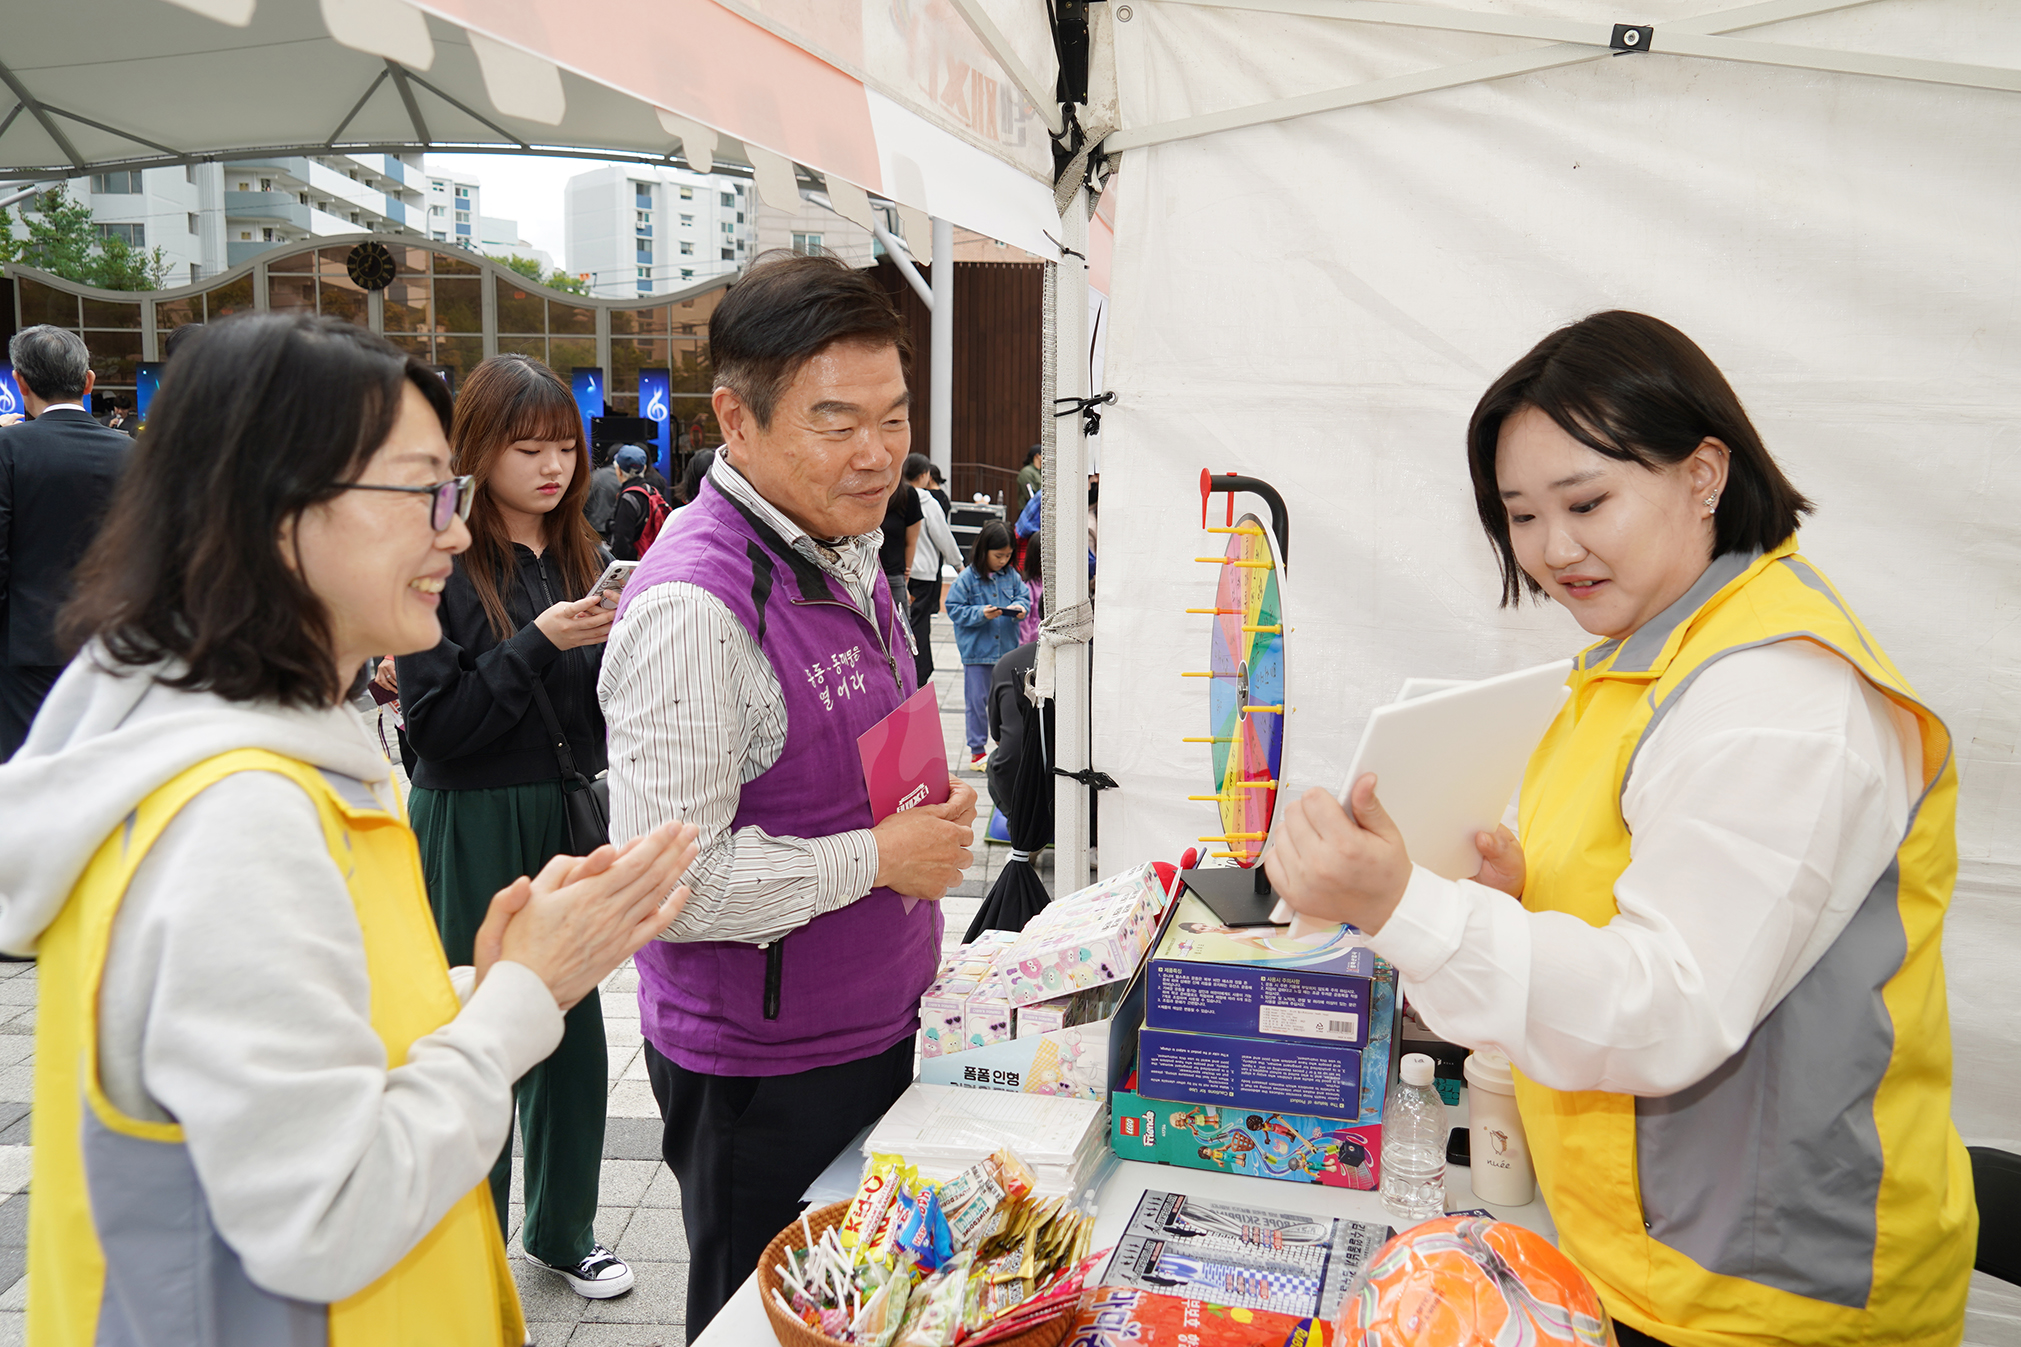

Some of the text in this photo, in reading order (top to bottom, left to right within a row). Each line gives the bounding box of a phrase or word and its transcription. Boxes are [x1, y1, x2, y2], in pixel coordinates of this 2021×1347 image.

[964, 1065, 1019, 1087] 폼폼 인형
[1125, 1118, 1134, 1135] LEGO
[1142, 1110, 1156, 1147] Friends
[845, 1175, 884, 1234] Kid-O
